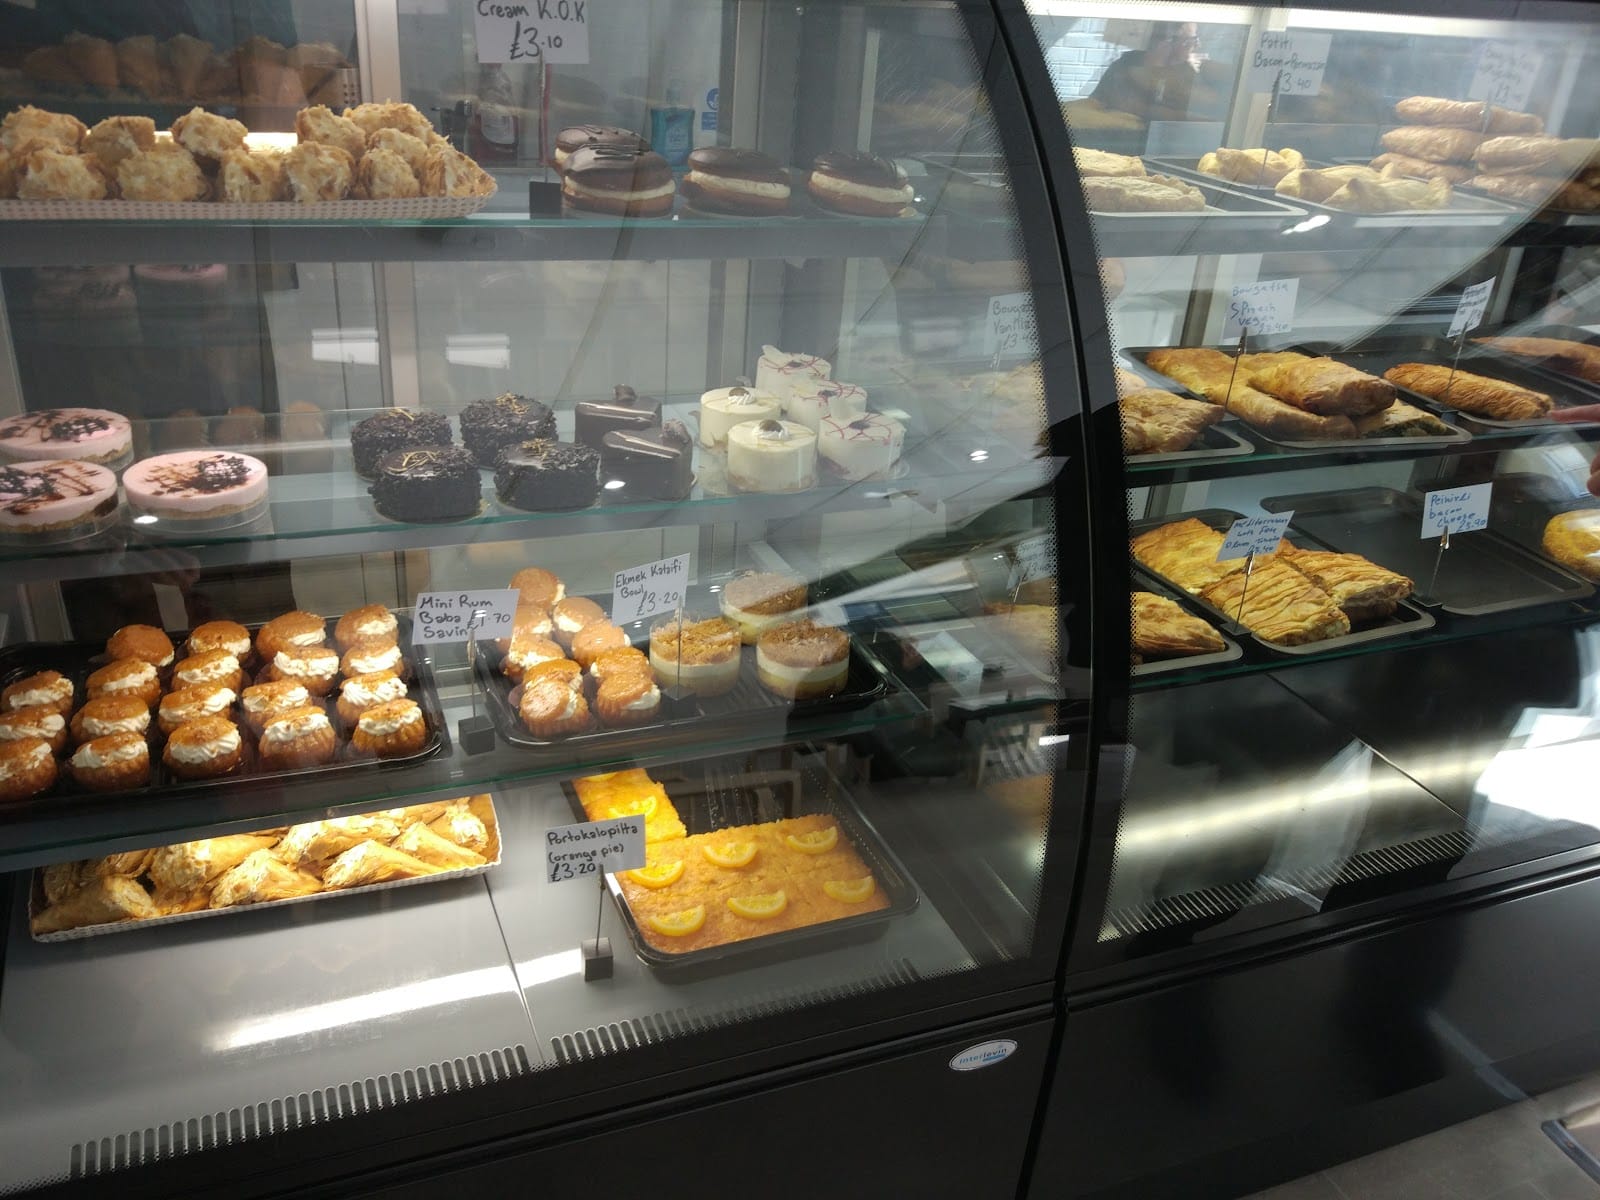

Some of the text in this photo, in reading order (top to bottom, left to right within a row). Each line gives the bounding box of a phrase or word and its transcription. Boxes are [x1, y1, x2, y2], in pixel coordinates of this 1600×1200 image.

[477, 0, 530, 19] Cream
[509, 20, 563, 60] £3.10
[620, 583, 644, 599] Bowl
[420, 594, 493, 609] Mini Rum
[636, 590, 679, 616] £3.20
[419, 611, 462, 624] Baba
[550, 862, 596, 882] £3.20
